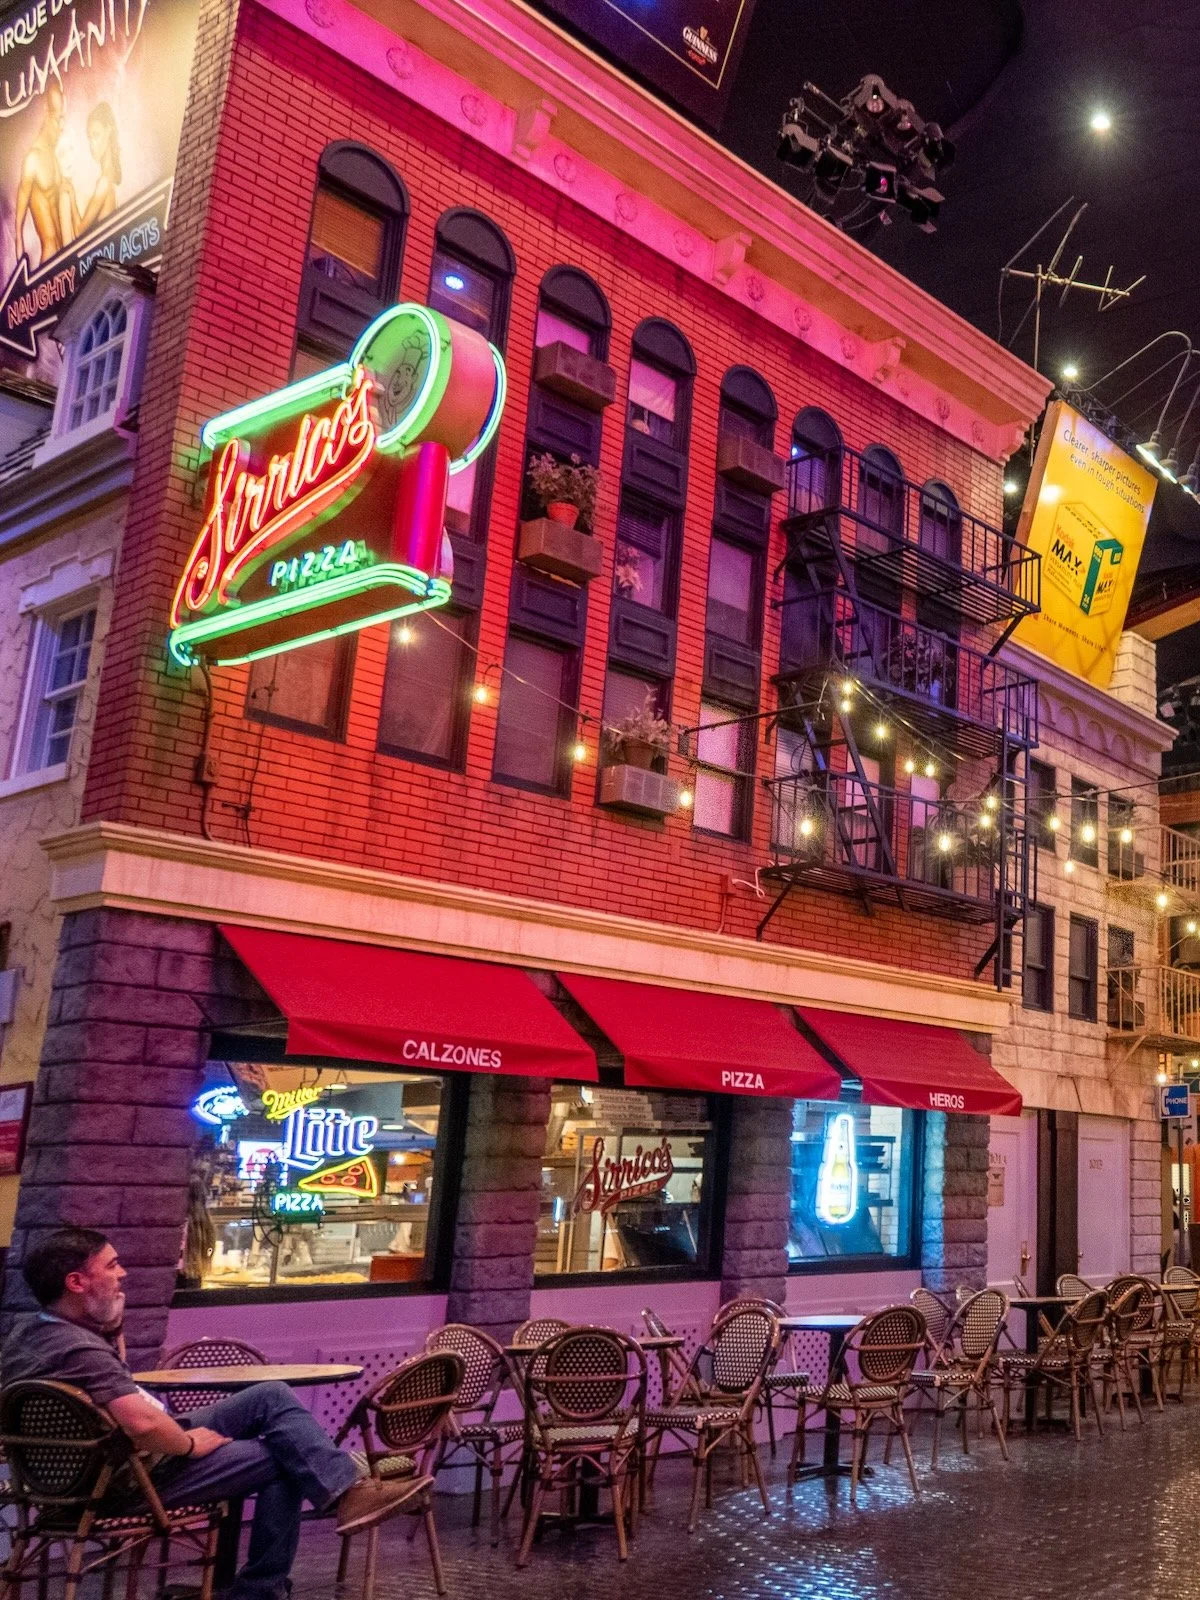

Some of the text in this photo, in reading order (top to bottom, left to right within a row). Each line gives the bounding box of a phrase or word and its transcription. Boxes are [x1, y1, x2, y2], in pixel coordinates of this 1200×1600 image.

[0, 0, 48, 57] IRQUE
[7, 265, 77, 330] NAUGHTY
[119, 217, 160, 264] ACTS
[1070, 453, 1145, 514] even in tough situations
[1091, 450, 1116, 475] sharper
[1115, 470, 1141, 495] pictures
[268, 539, 357, 588] PIZZA
[1051, 538, 1083, 577] MAX
[402, 1039, 502, 1069] CALZONES
[721, 1070, 765, 1090] PIZZA
[262, 1087, 323, 1119] Miller
[929, 1092, 965, 1109] HEROS
[1165, 1097, 1187, 1105] PHONE
[283, 1105, 378, 1170] Lite
[571, 1136, 673, 1216] Sirrico's
[620, 1181, 659, 1198] PIZZA
[274, 1192, 323, 1211] PIZZA
